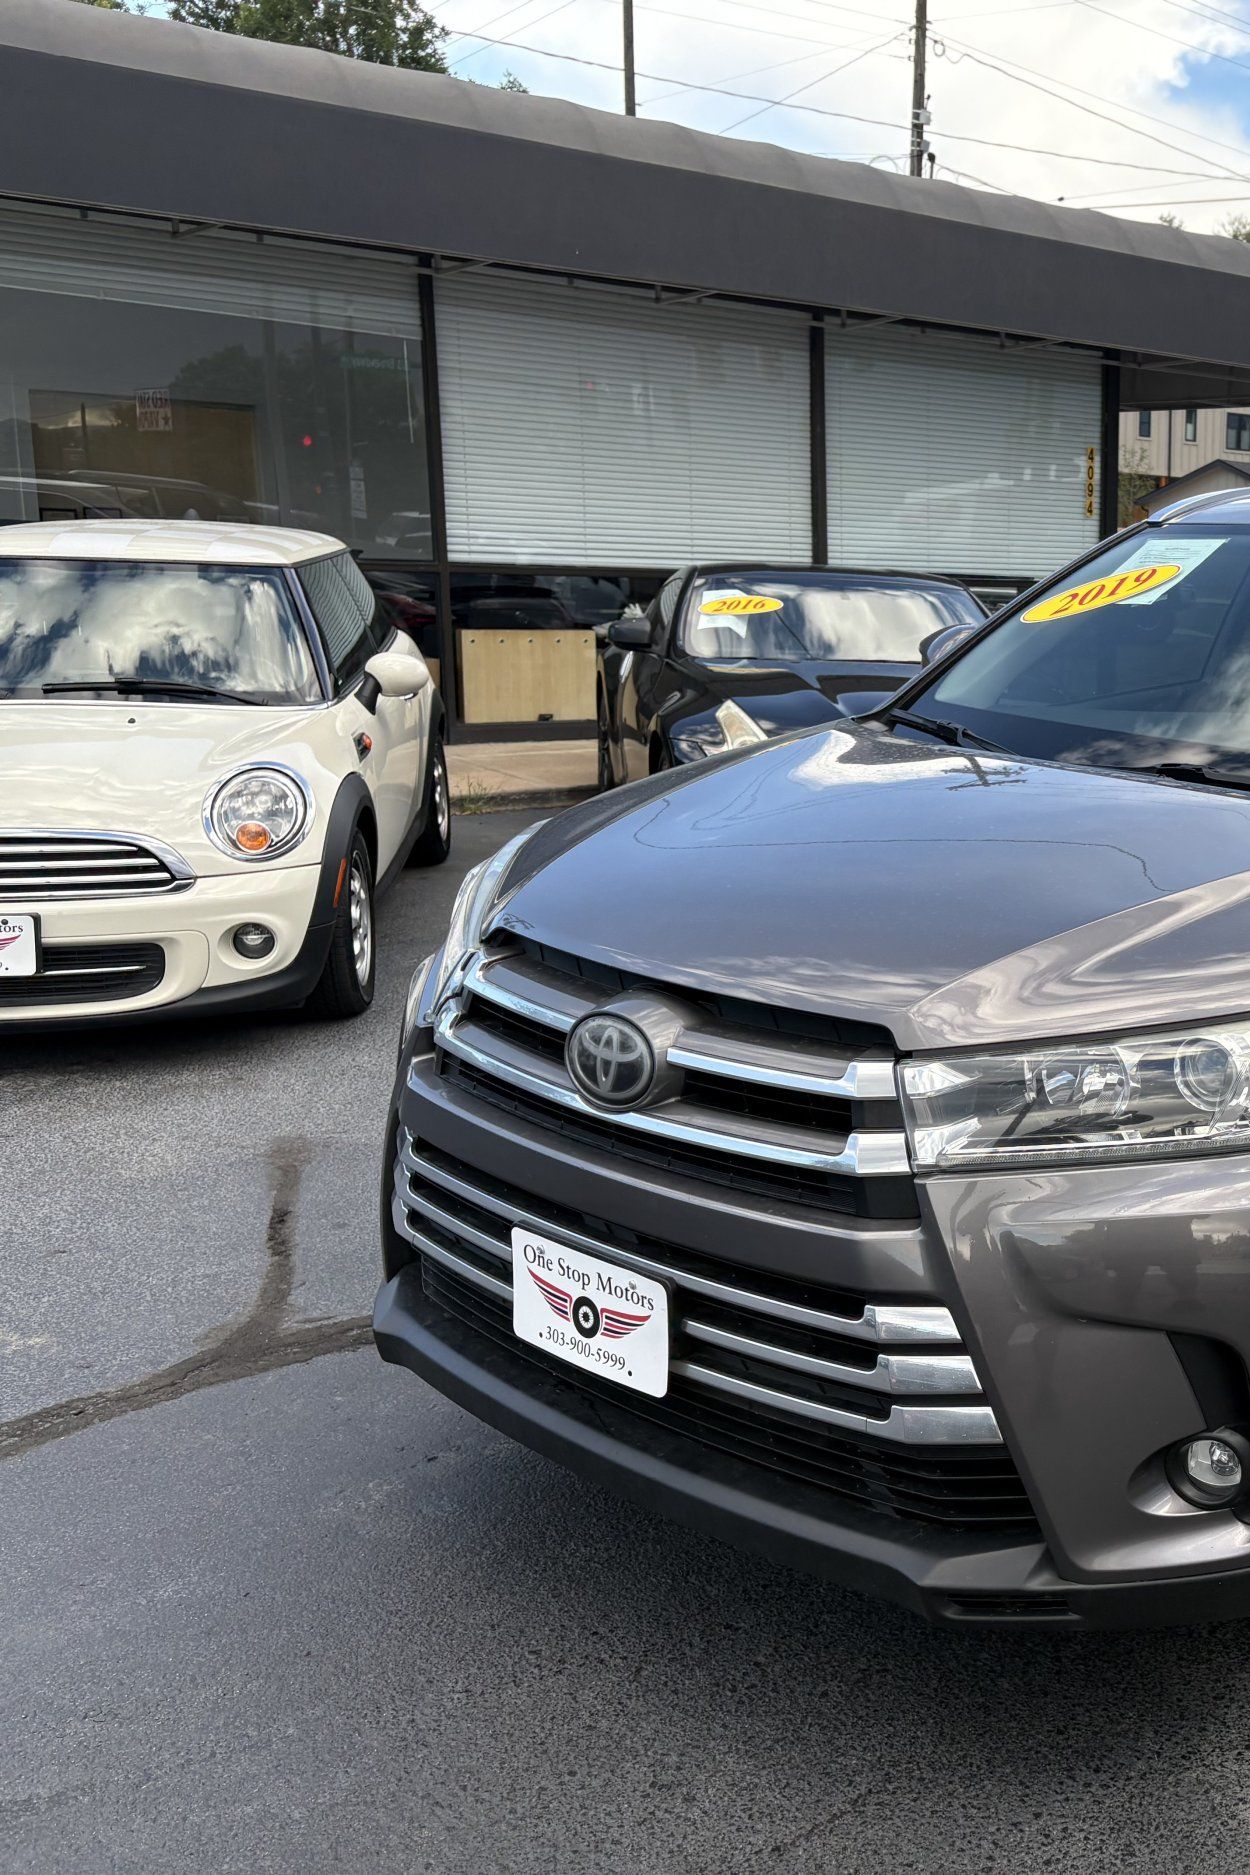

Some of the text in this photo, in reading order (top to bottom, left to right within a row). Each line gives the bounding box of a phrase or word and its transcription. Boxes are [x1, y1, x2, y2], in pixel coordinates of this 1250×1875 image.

[1086, 447, 1094, 516] 4094
[713, 600, 766, 612] 2016
[1049, 568, 1157, 616] 2019
[523, 1244, 654, 1311] One Stop Motors
[546, 1326, 626, 1371] 303-900-5999
